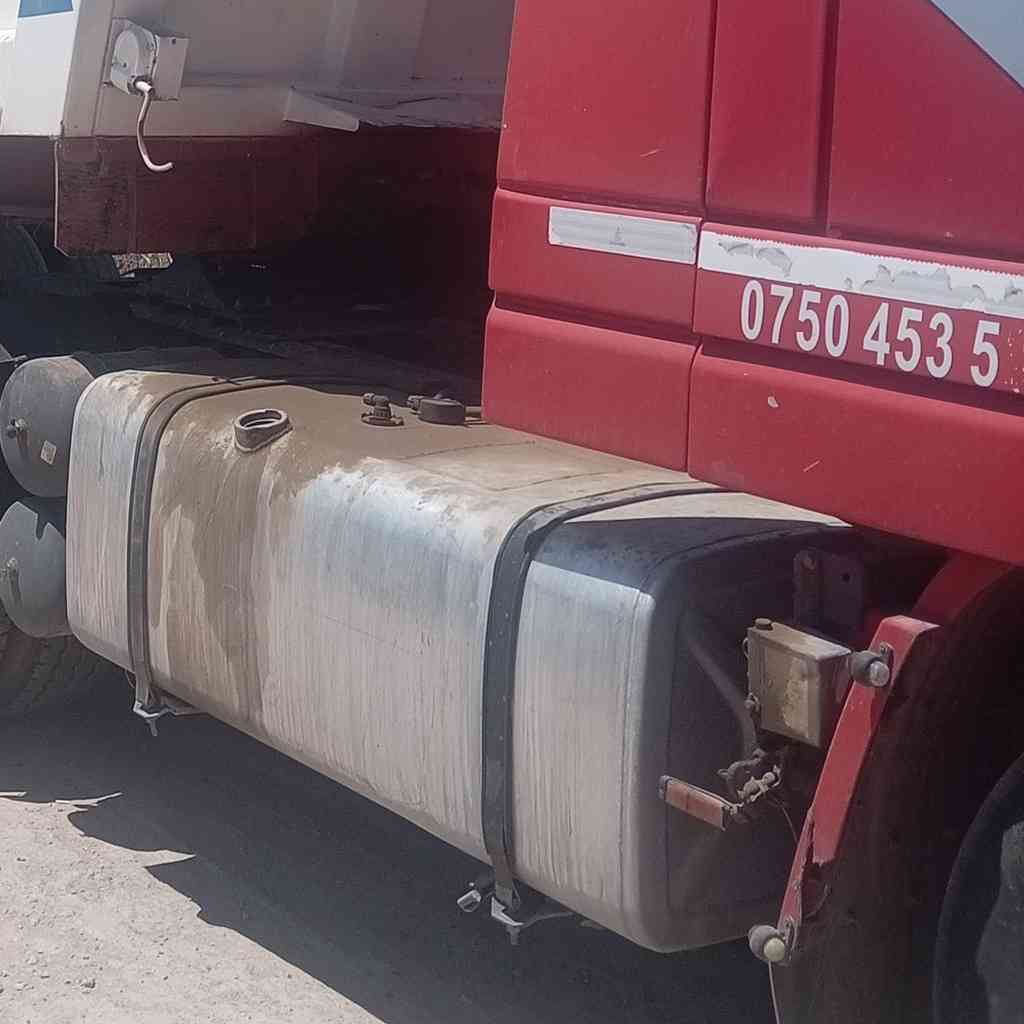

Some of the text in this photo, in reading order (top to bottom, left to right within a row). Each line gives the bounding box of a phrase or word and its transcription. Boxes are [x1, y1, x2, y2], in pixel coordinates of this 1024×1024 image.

[740, 279, 1001, 388] 0750 453 5
